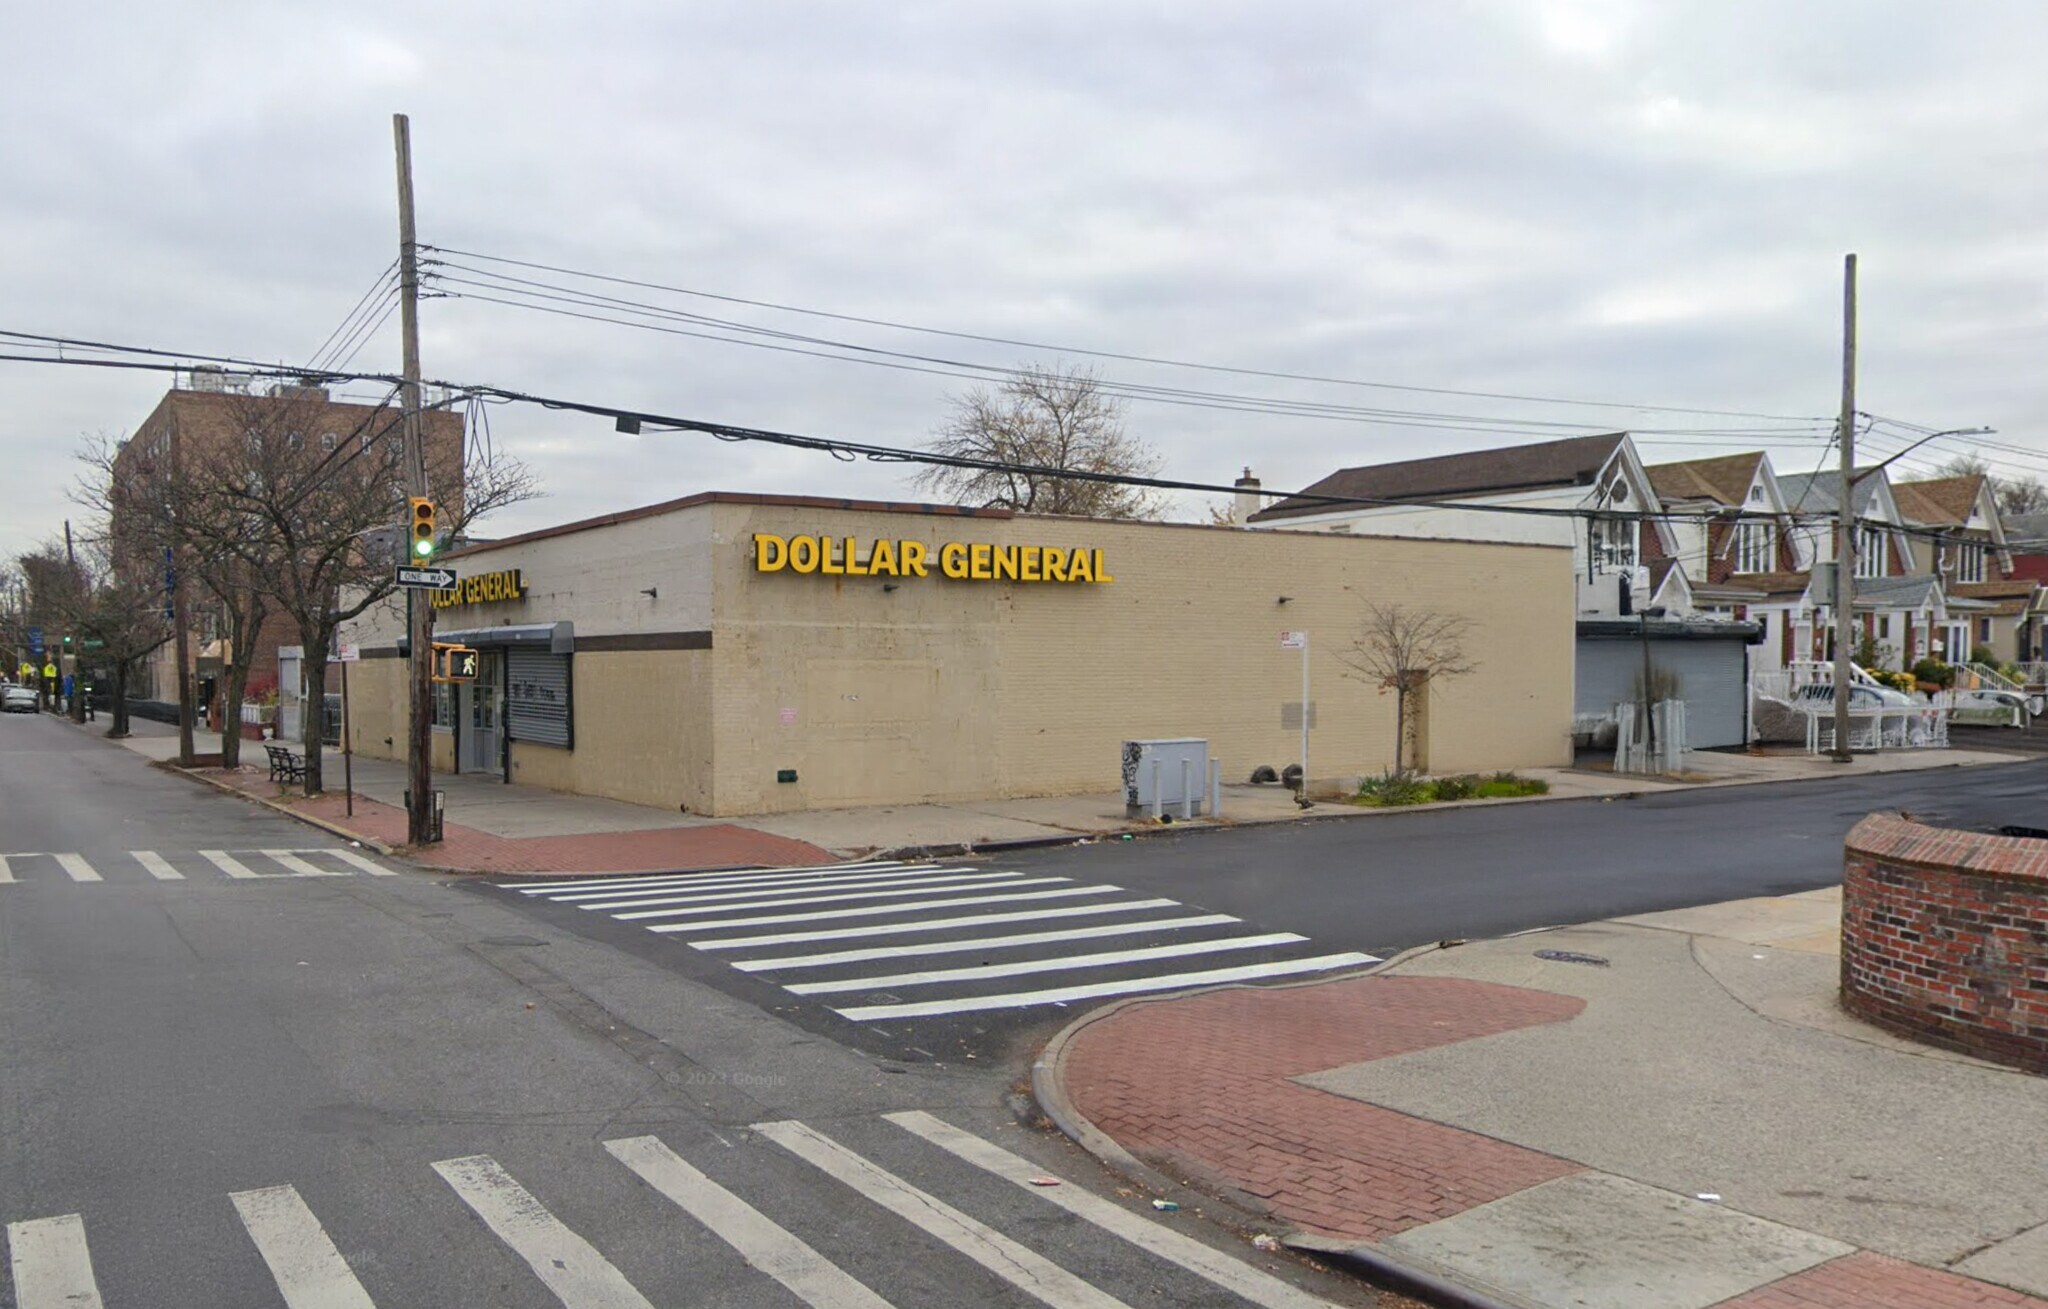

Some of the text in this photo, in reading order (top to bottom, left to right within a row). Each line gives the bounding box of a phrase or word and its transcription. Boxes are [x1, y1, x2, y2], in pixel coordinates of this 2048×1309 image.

[404, 571, 448, 583] ONE WAY
[752, 532, 1114, 583] DOLLAR GENERAL
[428, 569, 520, 609] OLLAR GENERAL
